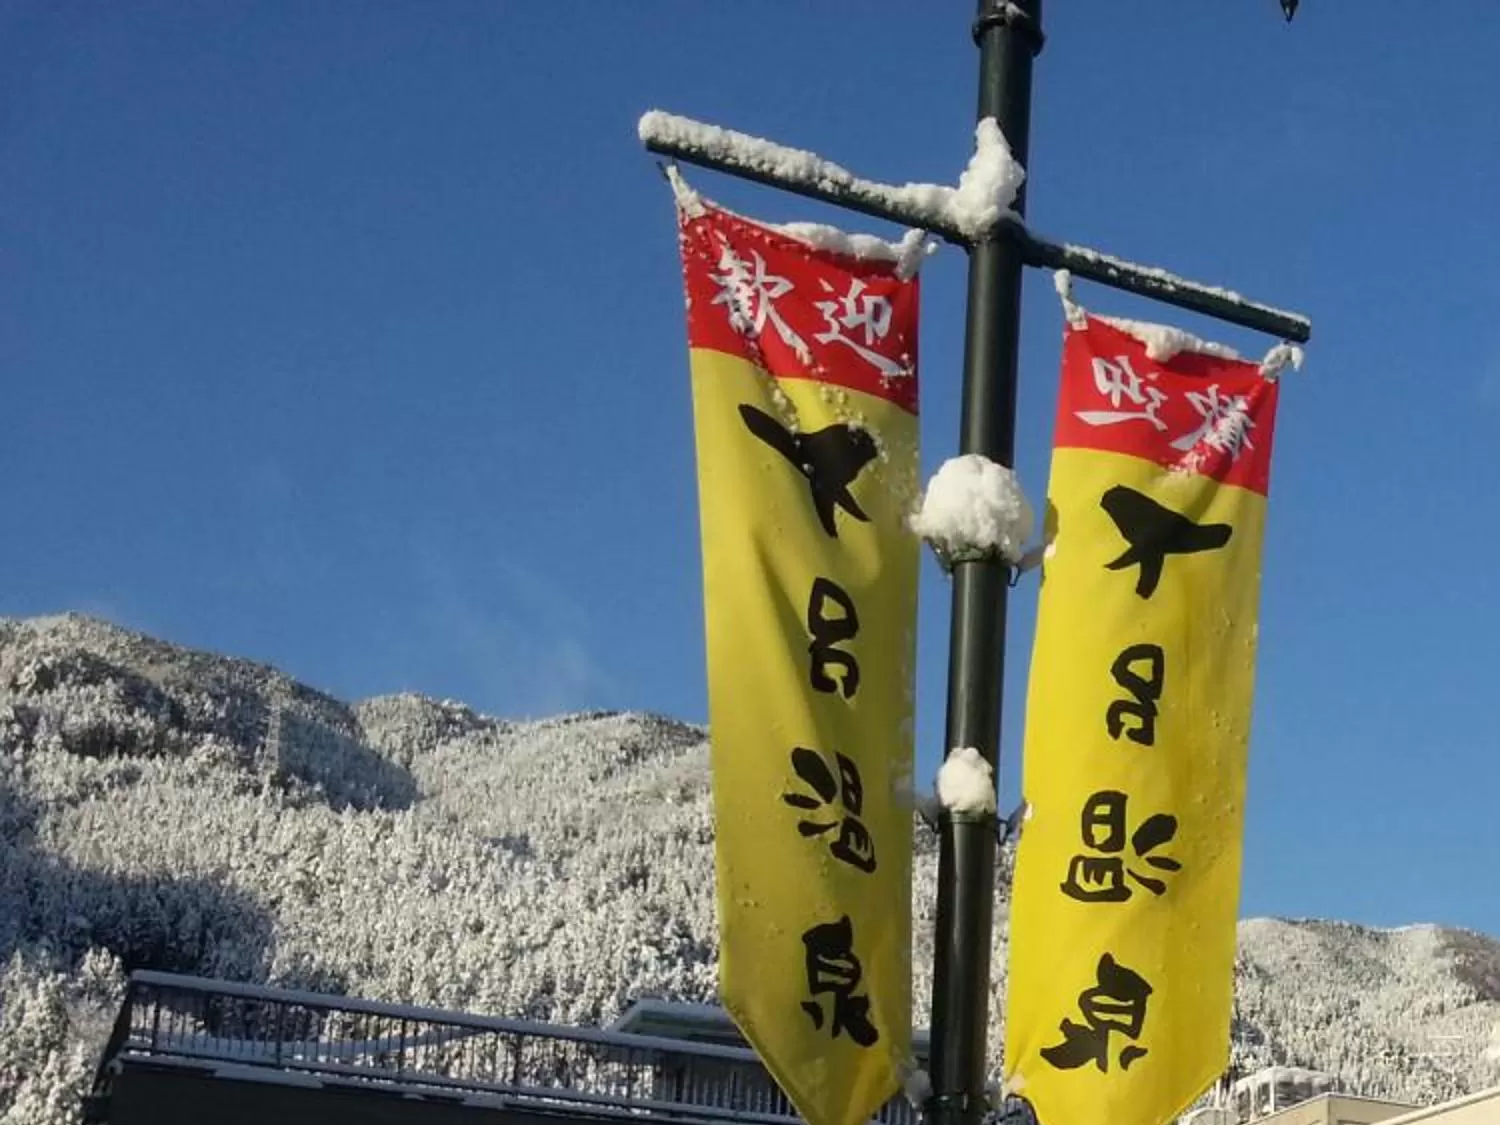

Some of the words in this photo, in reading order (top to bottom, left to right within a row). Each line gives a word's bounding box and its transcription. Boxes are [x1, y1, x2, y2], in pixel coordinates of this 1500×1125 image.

[710, 246, 912, 378] 歓迎
[738, 402, 879, 1047] 下呂温泉
